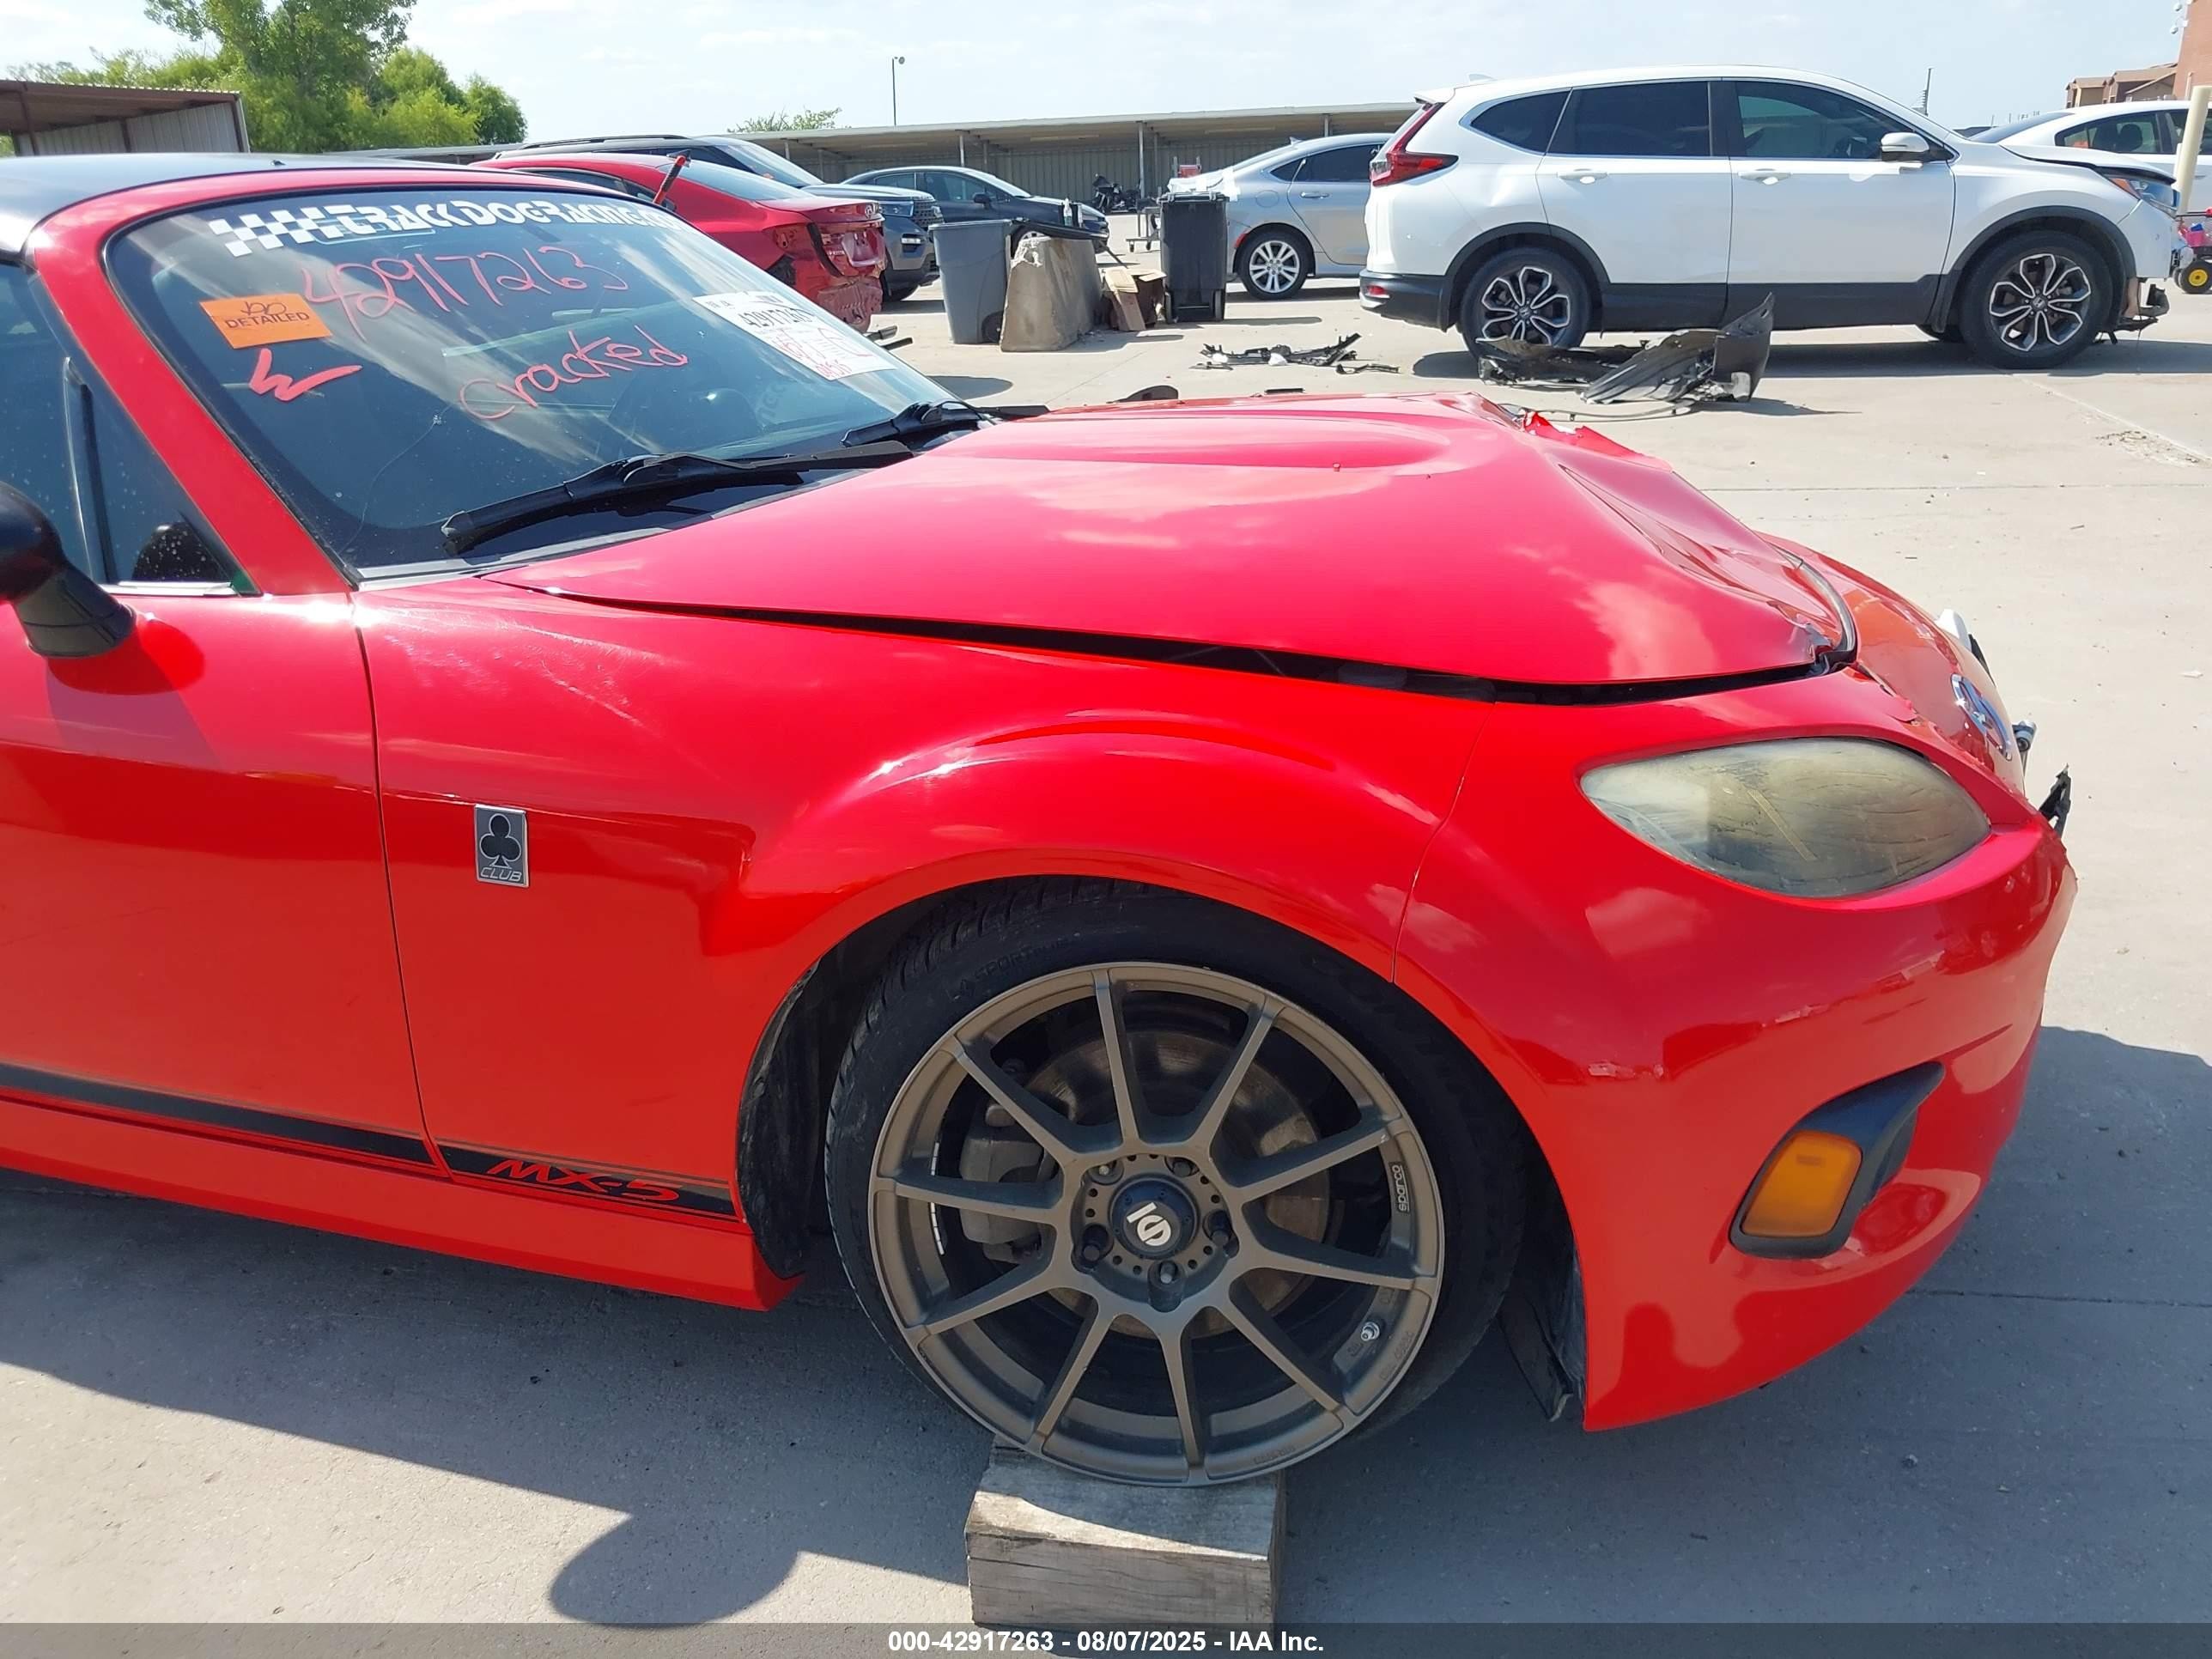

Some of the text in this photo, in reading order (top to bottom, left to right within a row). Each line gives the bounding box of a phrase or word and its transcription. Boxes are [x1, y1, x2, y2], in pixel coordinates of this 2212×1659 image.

[301, 246, 629, 341] 42917263
[224, 312, 310, 329] DETAILED
[479, 866, 522, 882] CLUB
[486, 1158, 680, 1201] MX-5
[1391, 1164, 1409, 1212] sparco
